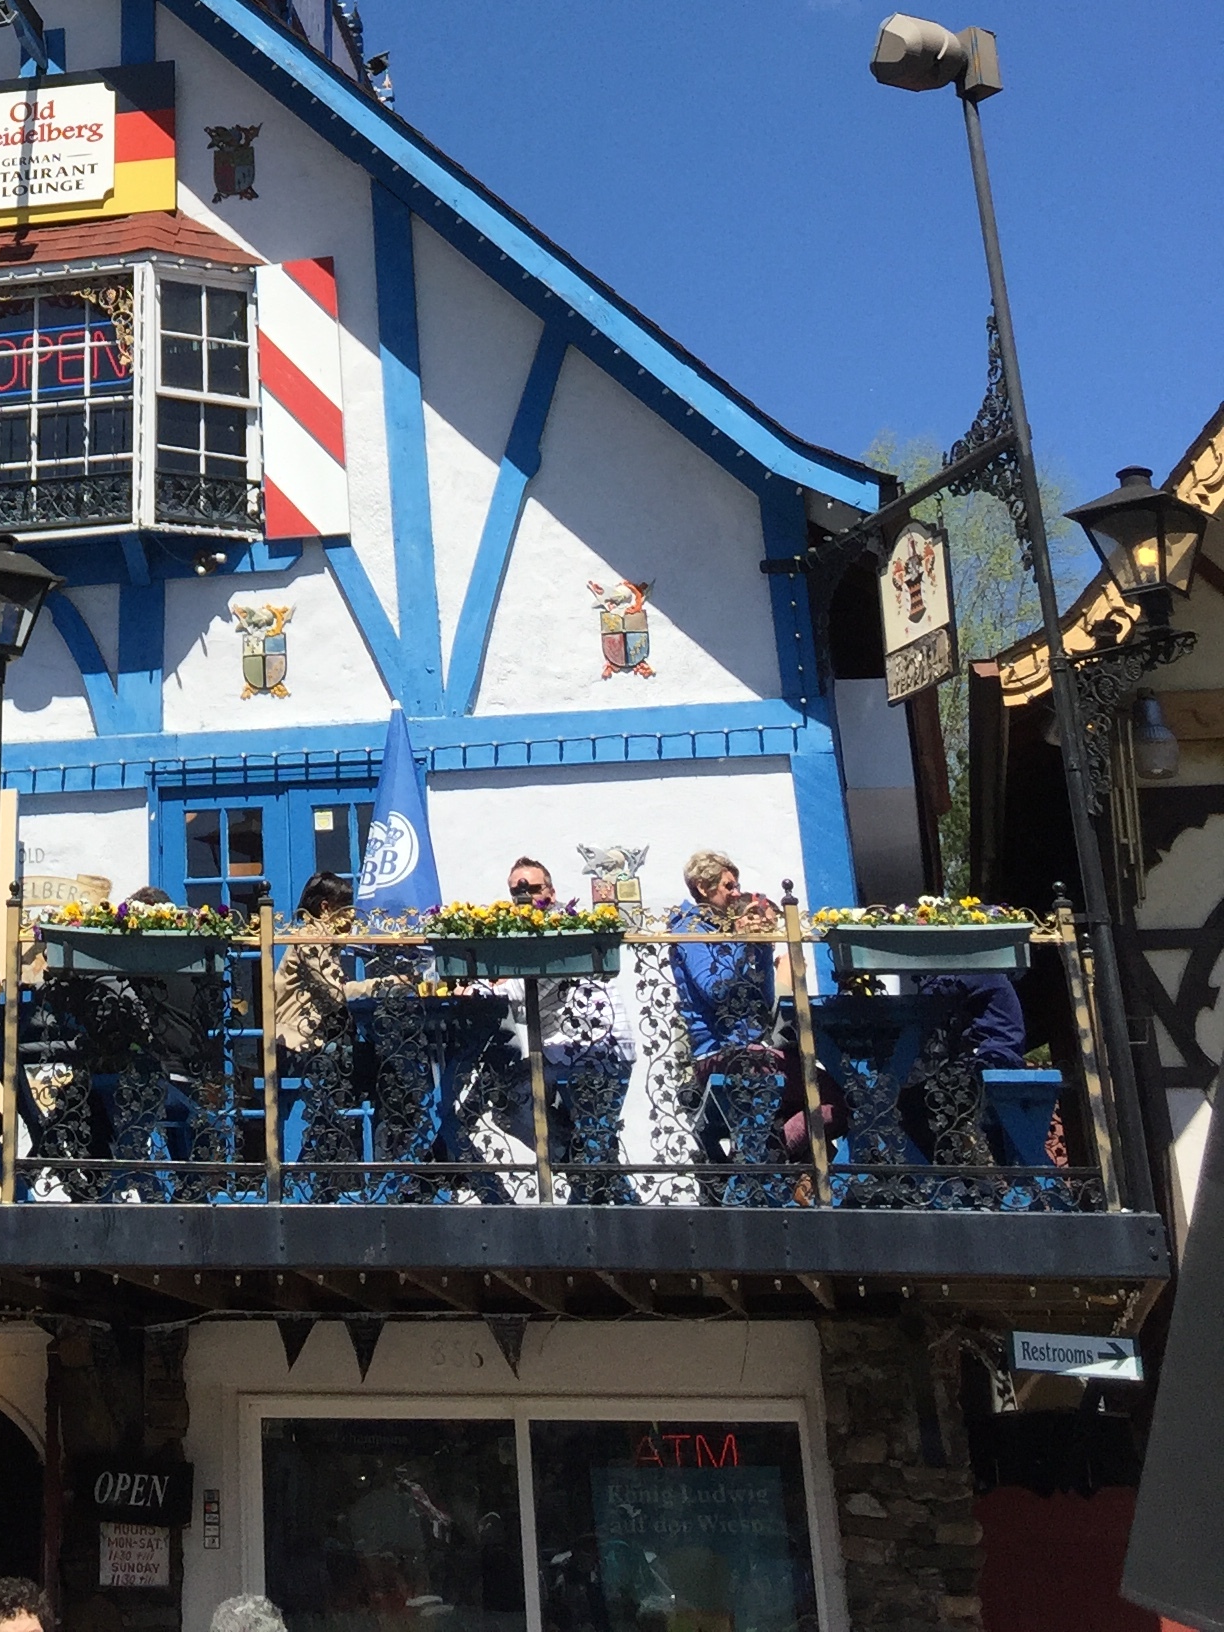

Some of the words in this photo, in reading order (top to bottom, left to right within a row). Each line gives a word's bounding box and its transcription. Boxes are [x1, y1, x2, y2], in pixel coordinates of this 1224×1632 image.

[9, 99, 56, 123] Old
[1, 152, 62, 167] GERMAN
[1, 179, 85, 198] LOUNGE
[19, 848, 45, 864] OLD
[1021, 1340, 1094, 1365] Restrooms
[634, 1433, 739, 1469] ATM
[94, 1470, 170, 1507] OPEN
[113, 1523, 156, 1536] HOURS
[111, 1562, 160, 1574] SUNDAY
